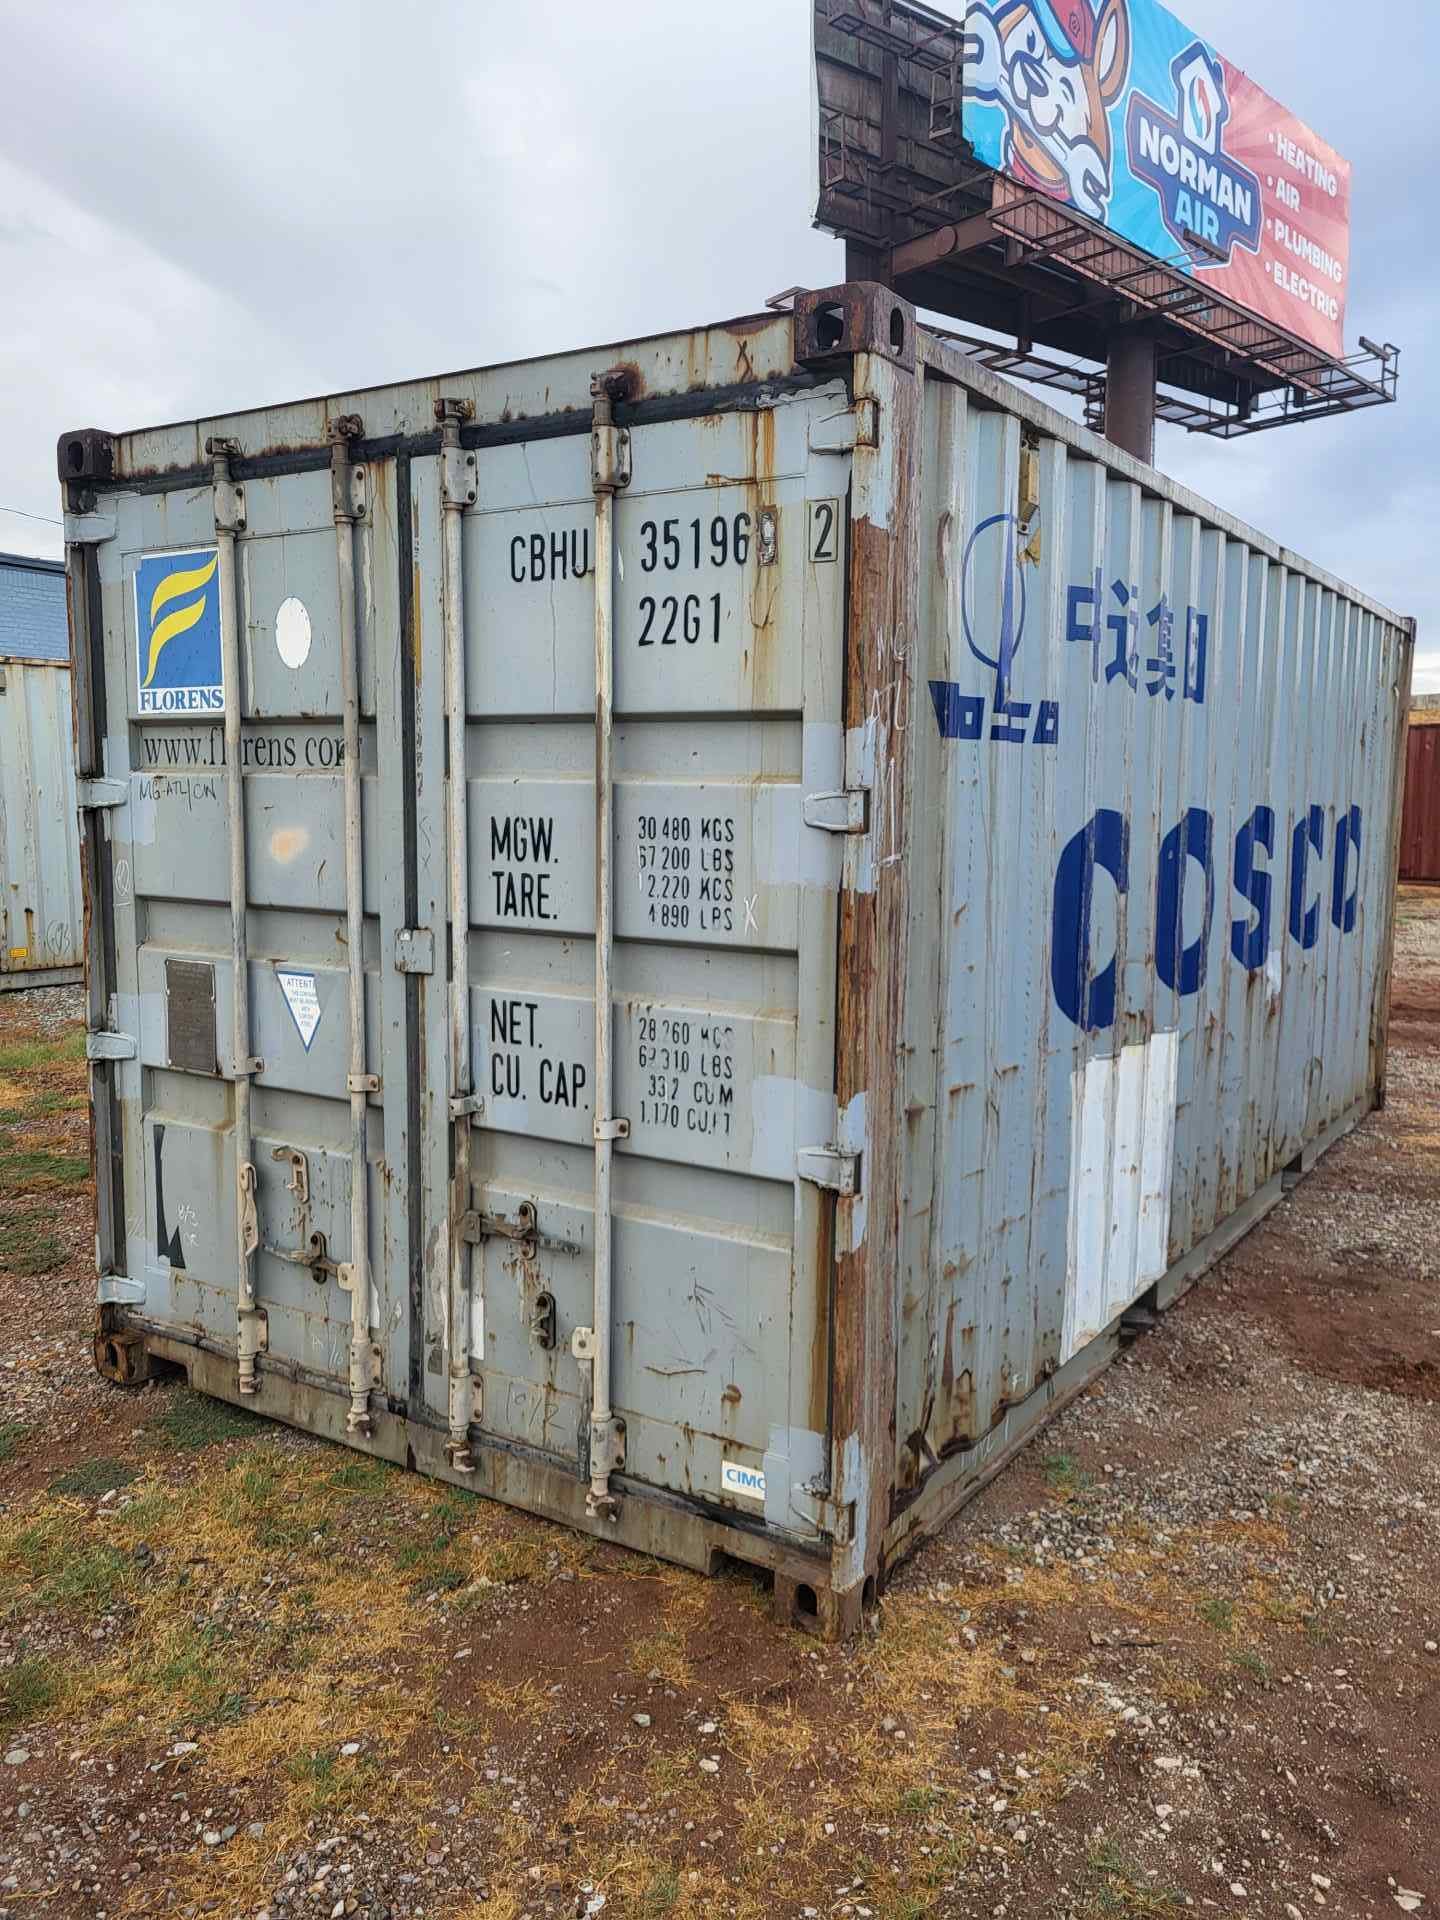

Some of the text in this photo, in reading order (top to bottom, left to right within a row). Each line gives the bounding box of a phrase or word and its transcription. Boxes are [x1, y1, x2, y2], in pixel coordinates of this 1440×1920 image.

[1140, 116, 1252, 226] NORMAN
[1276, 132, 1338, 197] HEATING
[1174, 187, 1219, 247] AIR
[1276, 175, 1301, 213] AIR
[1275, 216, 1343, 284] PLUMBING
[1274, 260, 1339, 321] ELECTRIC
[510, 528, 590, 583] CBHU
[813, 502, 834, 559] 2
[637, 592, 722, 647] 22G1
[140, 687, 224, 711] FLORENS
[491, 816, 559, 864] MGW.
[701, 818, 735, 843] KGS
[701, 847, 734, 872] LBS
[492, 871, 558, 920] TARE.
[1051, 804, 1362, 1033] COSCO
[491, 998, 543, 1049] NET.
[491, 1054, 527, 1101] CU.
[539, 1060, 590, 1111] CAP.
[700, 1053, 733, 1079] LBS
